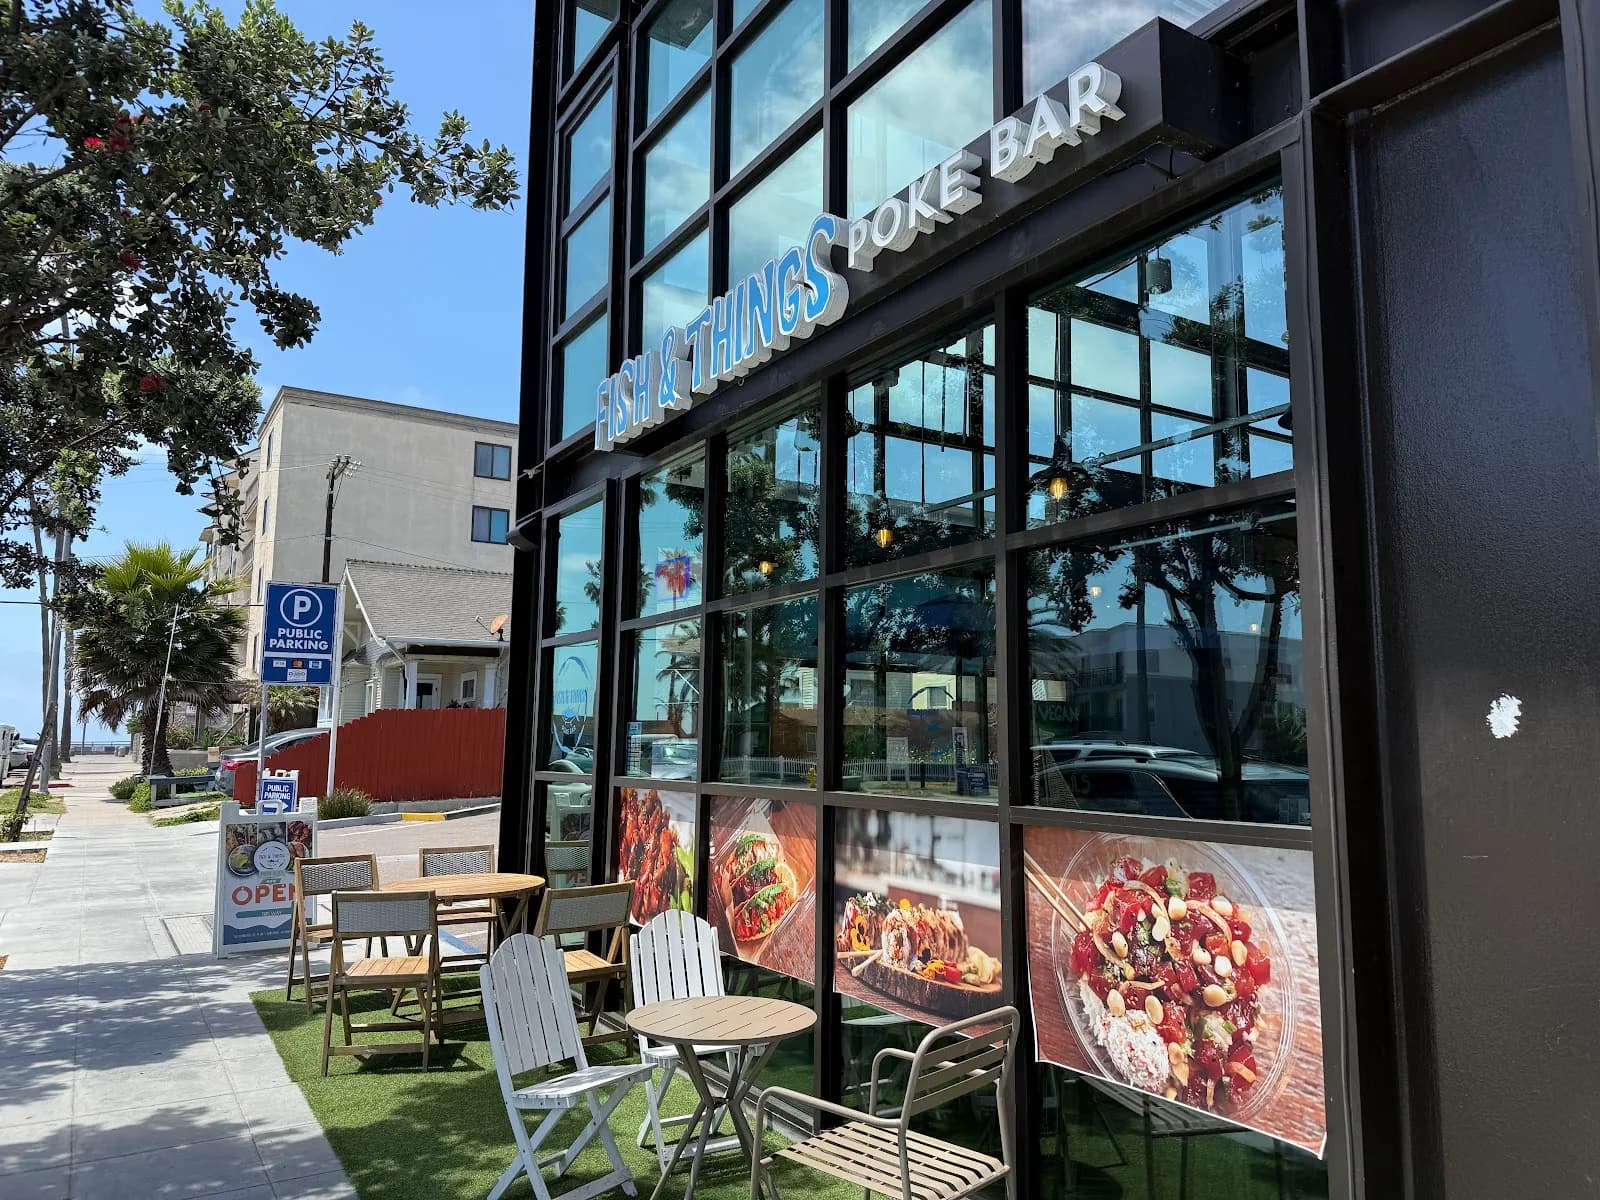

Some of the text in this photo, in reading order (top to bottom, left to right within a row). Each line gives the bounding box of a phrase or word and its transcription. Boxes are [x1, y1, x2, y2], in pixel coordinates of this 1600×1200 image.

[594, 61, 1127, 451] FISH & THINGS POKE BAR
[293, 595, 312, 620] P
[277, 627, 323, 639] PUBLIC
[269, 639, 328, 650] PARKING
[1039, 705, 1080, 722] VEGAN
[267, 784, 290, 792] PUBLIC
[263, 791, 291, 800] PARKING
